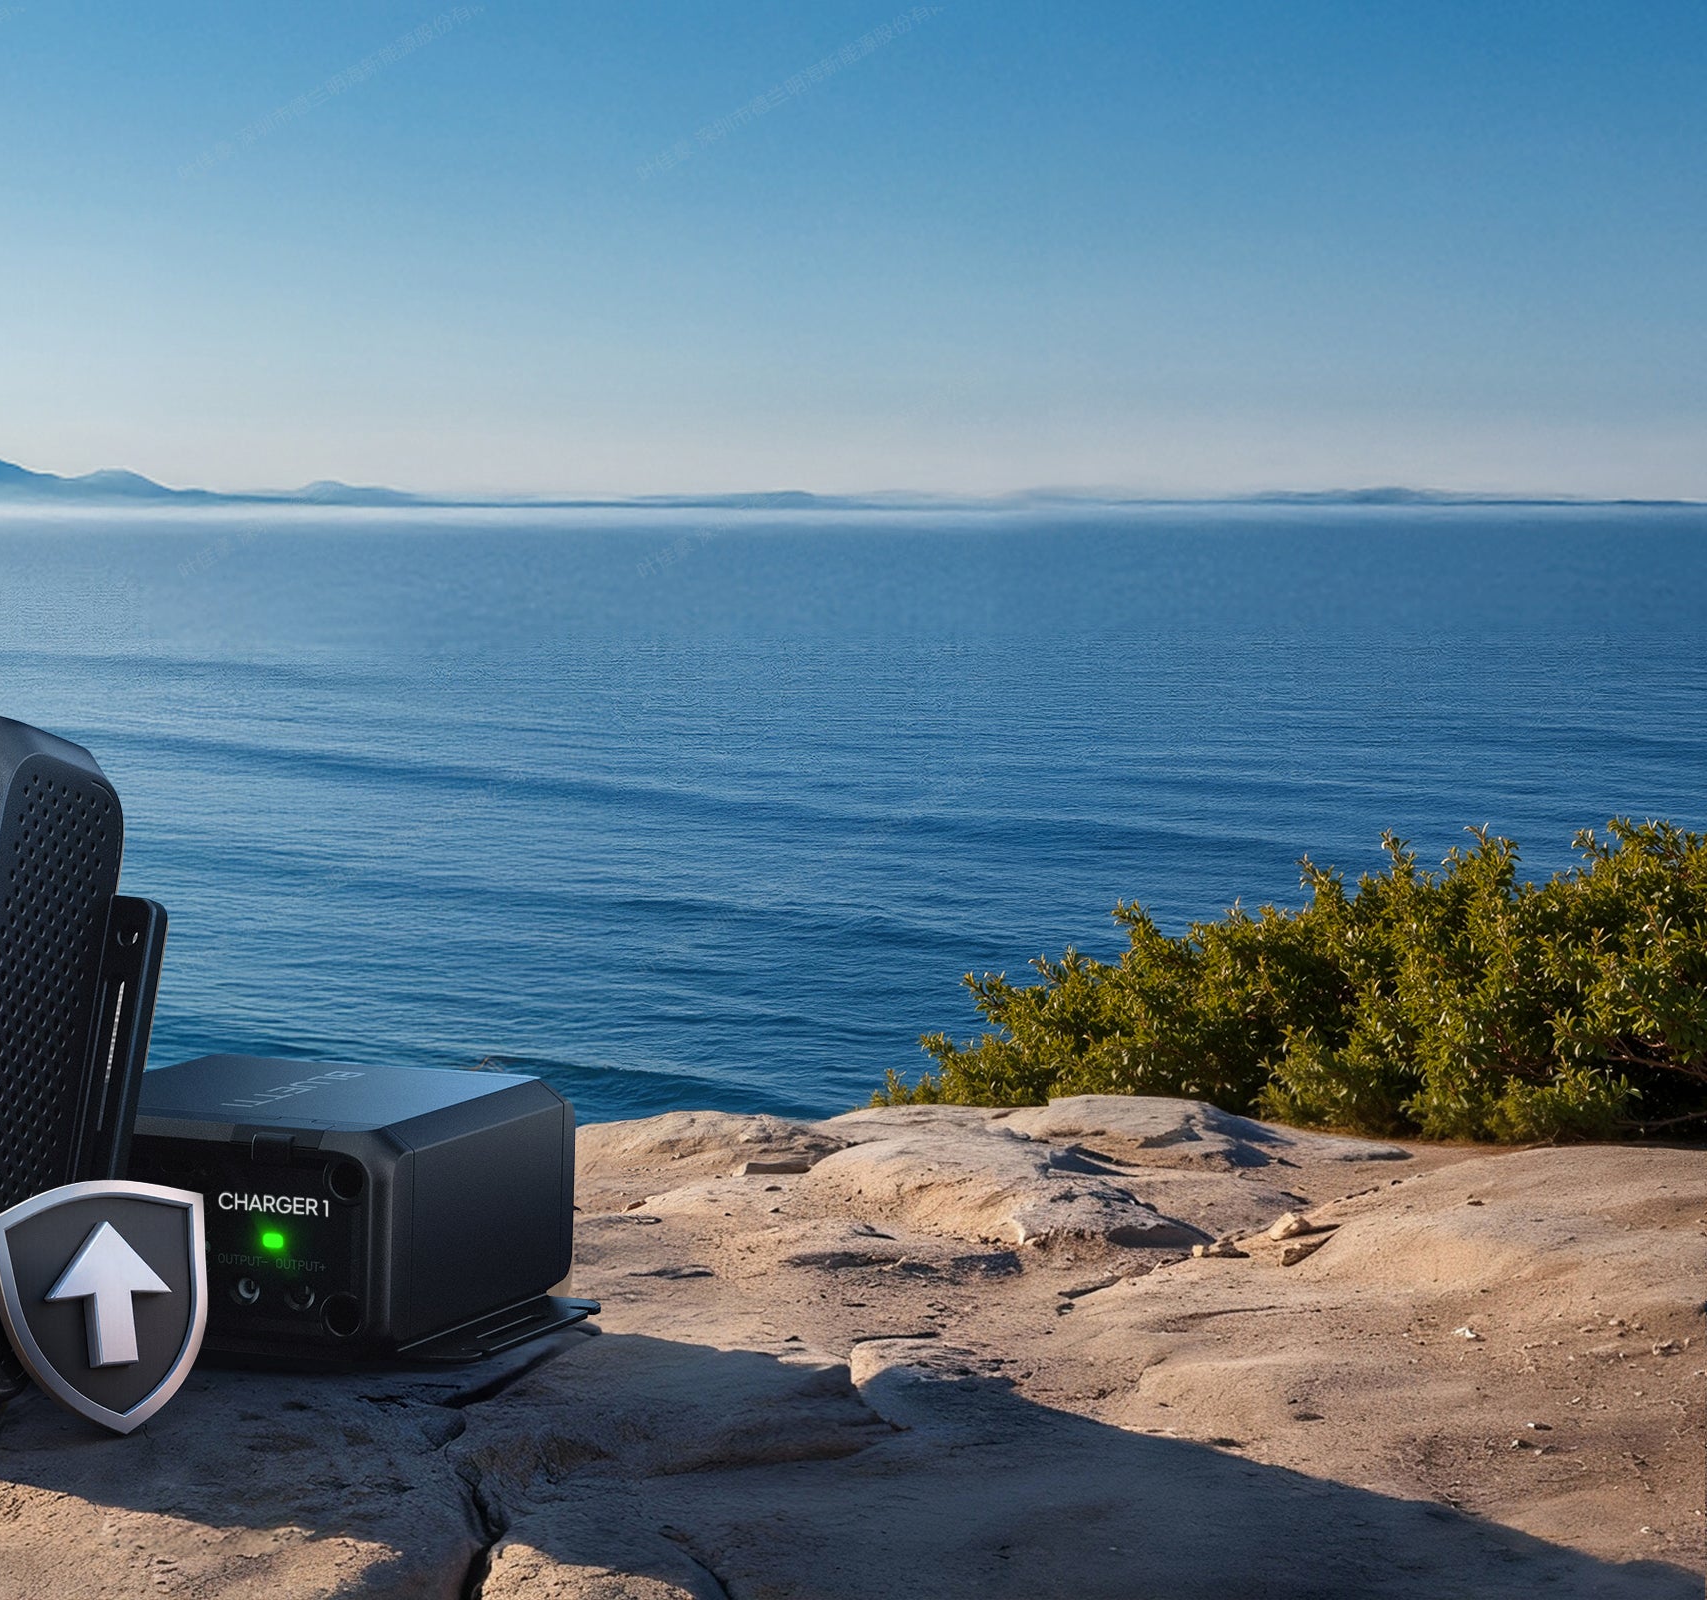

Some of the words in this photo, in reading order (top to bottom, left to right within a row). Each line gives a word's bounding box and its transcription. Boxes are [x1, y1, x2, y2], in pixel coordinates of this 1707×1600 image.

[220, 1070, 366, 1107] BLUETTI
[218, 1192, 319, 1216] CHARGER
[322, 1200, 330, 1218] 1
